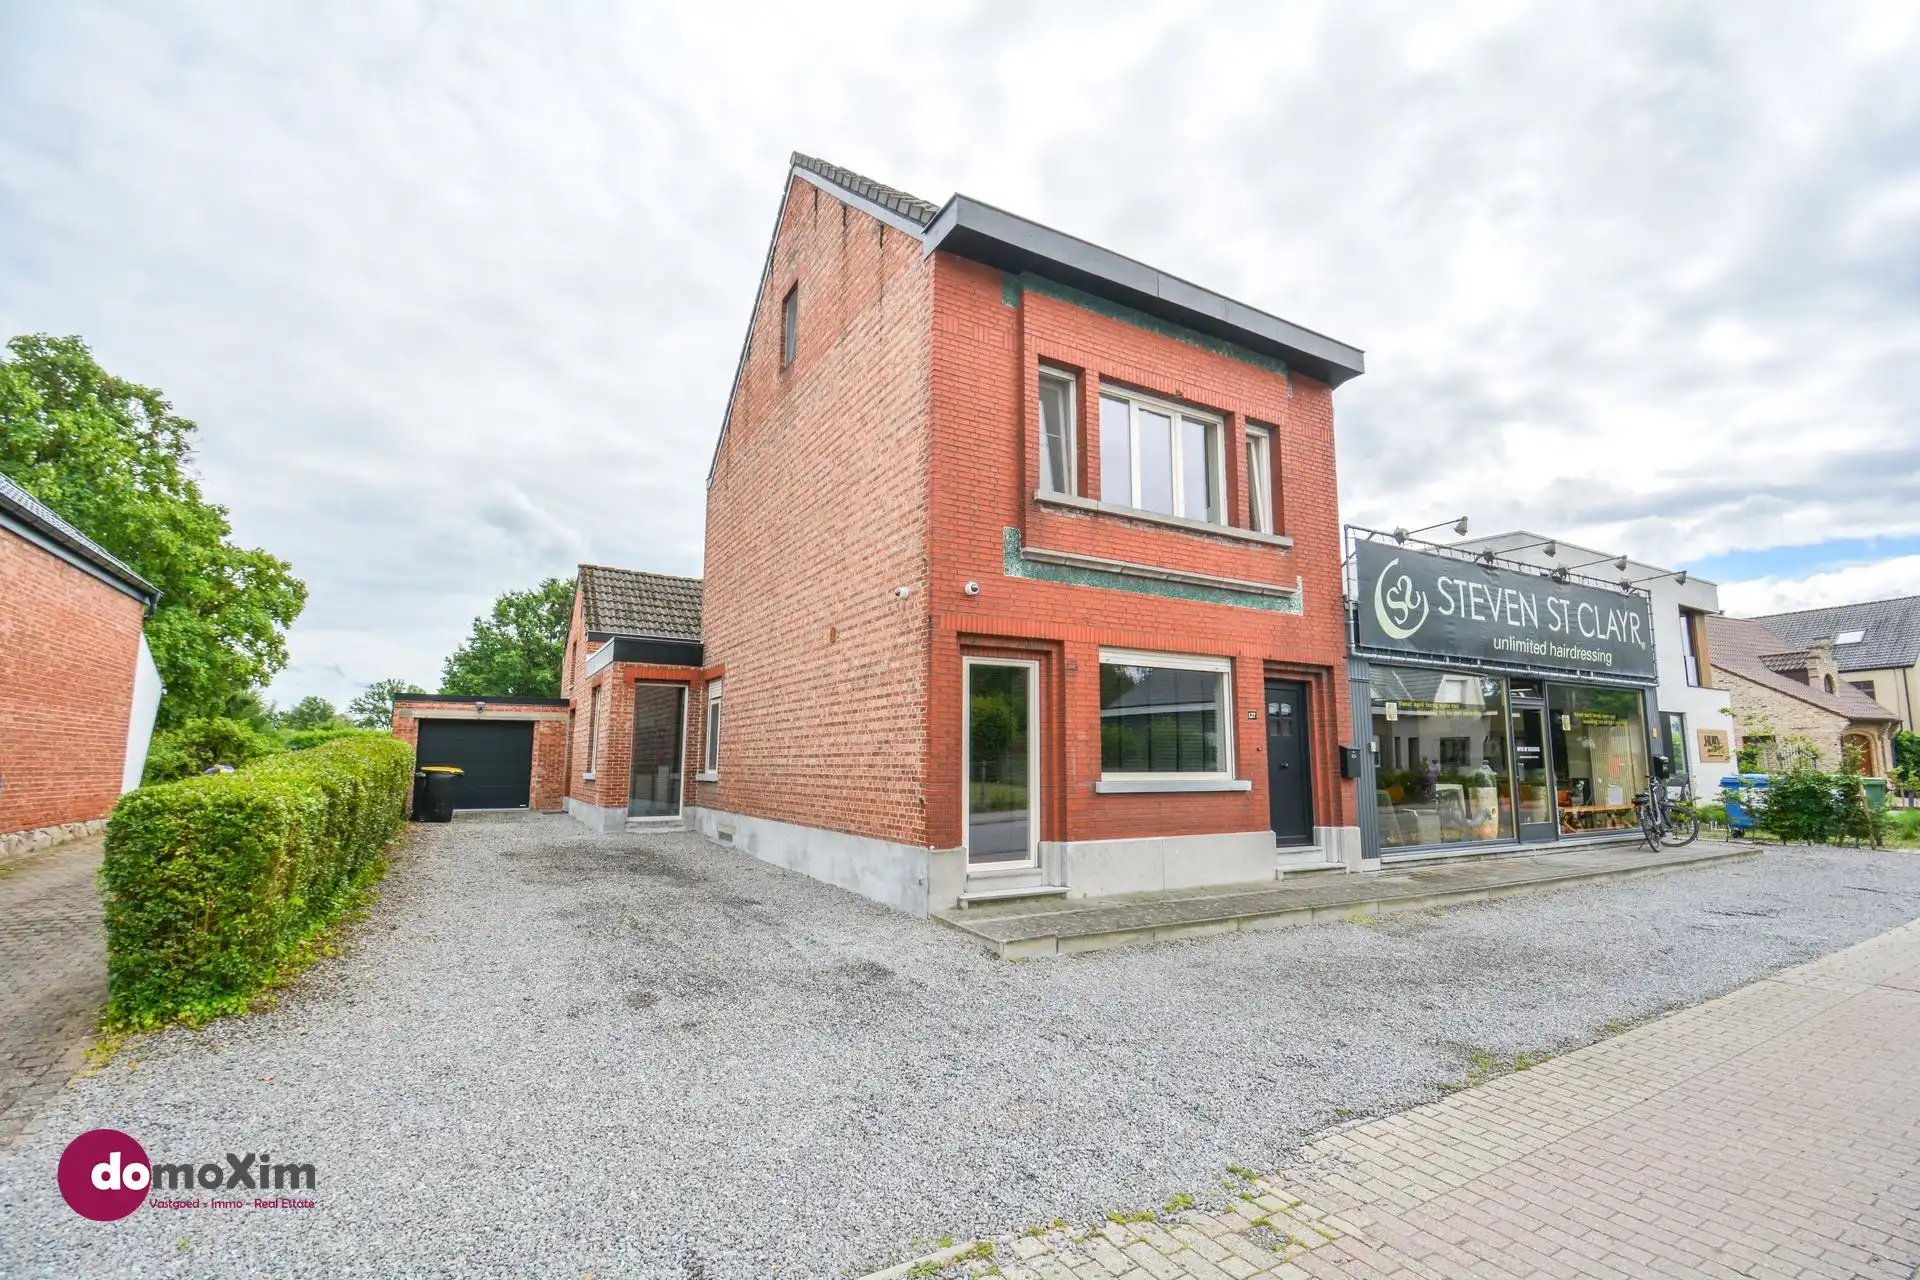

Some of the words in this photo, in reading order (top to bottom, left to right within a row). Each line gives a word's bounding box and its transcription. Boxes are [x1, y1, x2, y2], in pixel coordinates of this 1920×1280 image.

[1437, 575, 1539, 629] STEVEN
[1546, 596, 1571, 634] ST
[1493, 635, 1547, 656] unlimited
[1550, 641, 1612, 666] hairdressing
